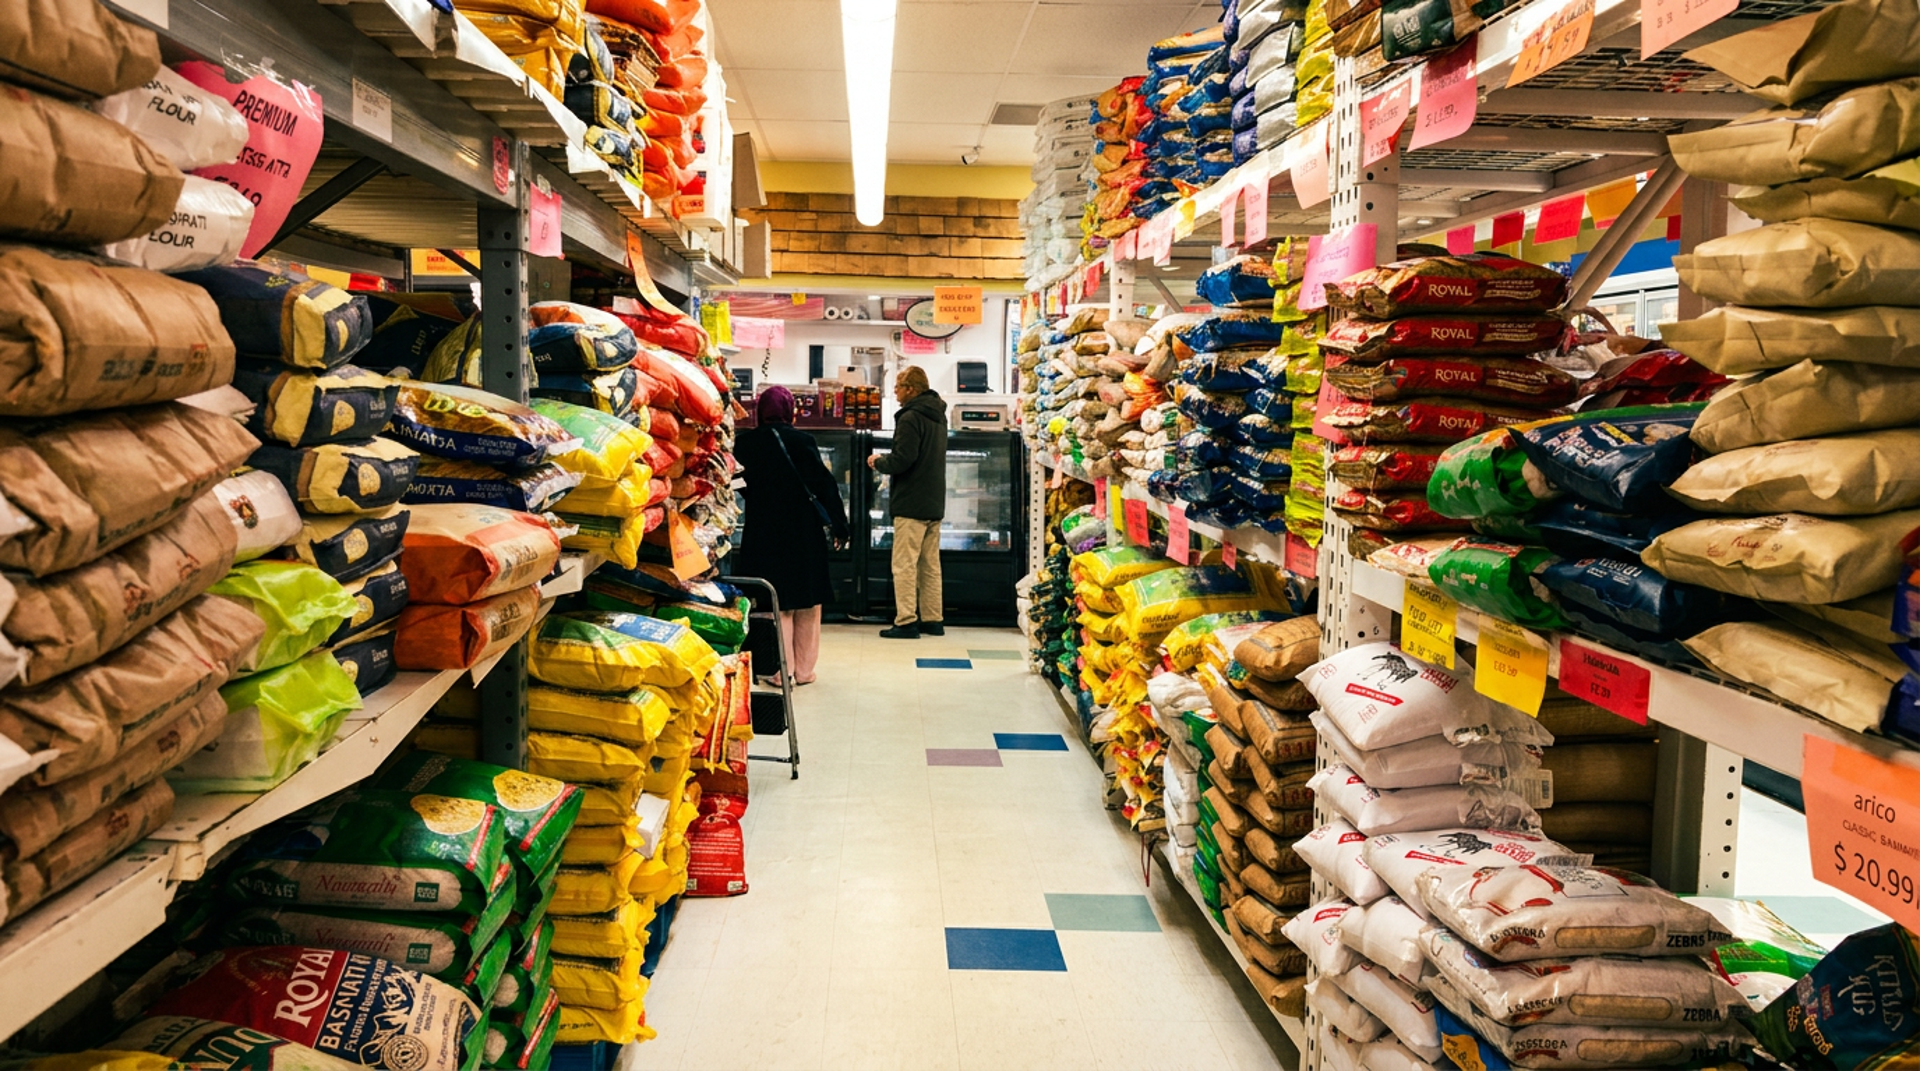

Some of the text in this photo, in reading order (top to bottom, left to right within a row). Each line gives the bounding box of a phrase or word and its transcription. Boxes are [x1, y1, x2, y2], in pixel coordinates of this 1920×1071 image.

[148, 95, 197, 126] FLOUR
[232, 89, 298, 137] PREMIUM
[1428, 283, 1473, 298] ROYAL
[1430, 326, 1474, 341] ROYAL
[1435, 368, 1477, 383] ROYAL
[1854, 794, 1896, 824] arico
[1834, 841, 1914, 905] $ 20.99
